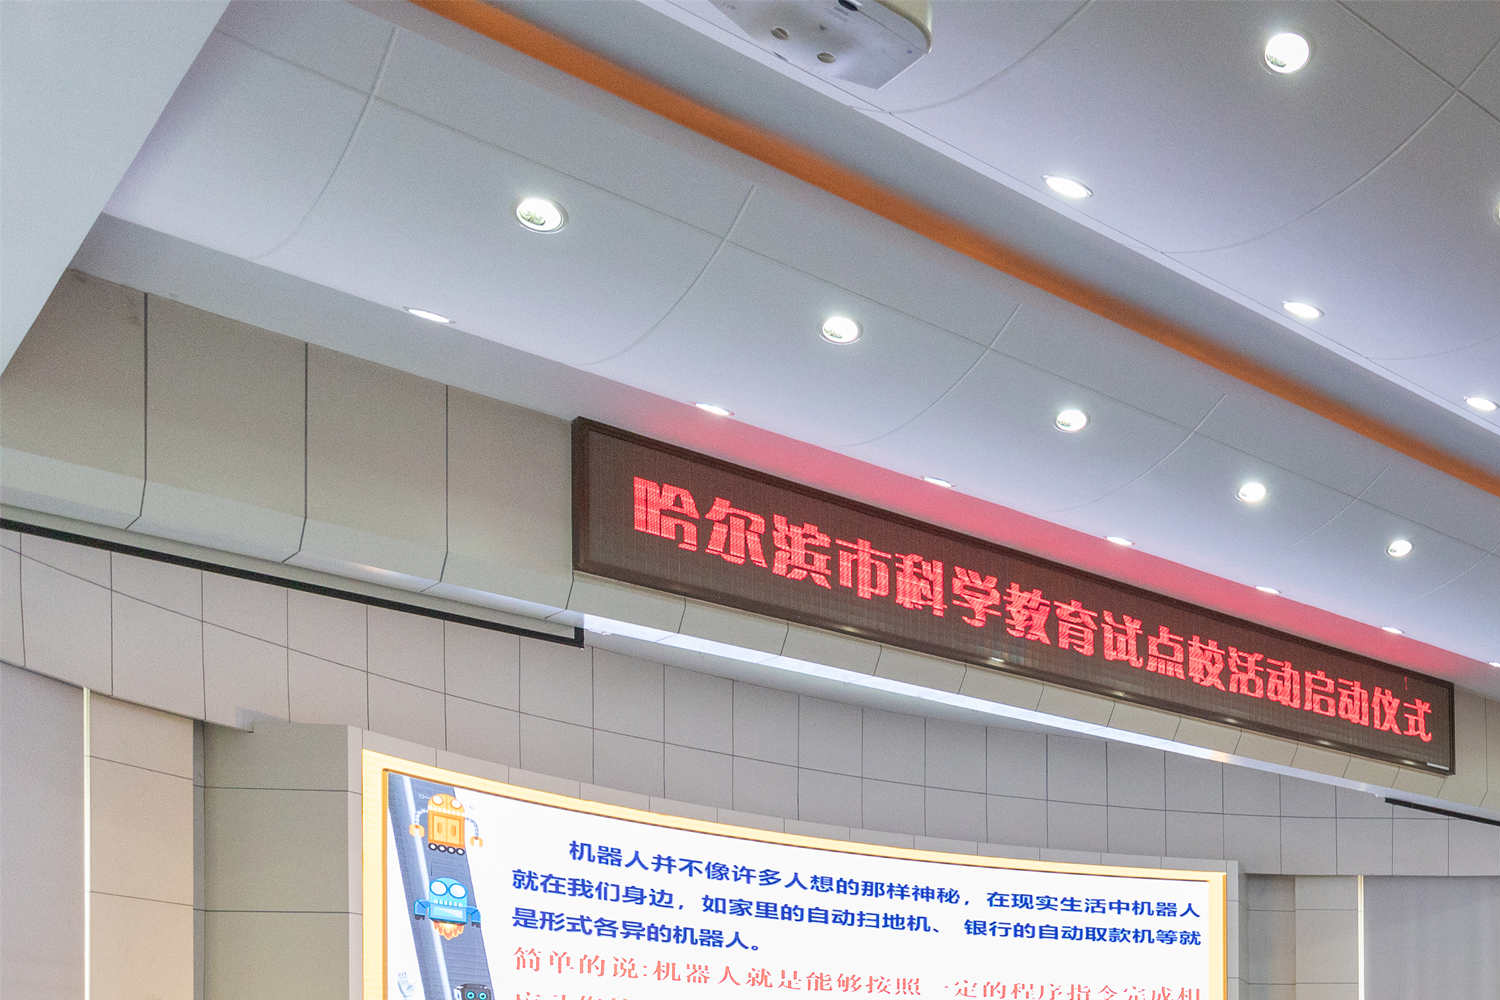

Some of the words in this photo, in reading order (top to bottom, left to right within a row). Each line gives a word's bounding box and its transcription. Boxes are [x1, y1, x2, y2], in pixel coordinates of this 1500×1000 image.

[633, 476, 1433, 743] 哈尔滨市科学教育试点校活动启动仪式
[569, 840, 1201, 918] 机器人并不像许多人想的那样神秘，在现实生活中机器人
[511, 906, 760, 951] 是形式各异的机器人。
